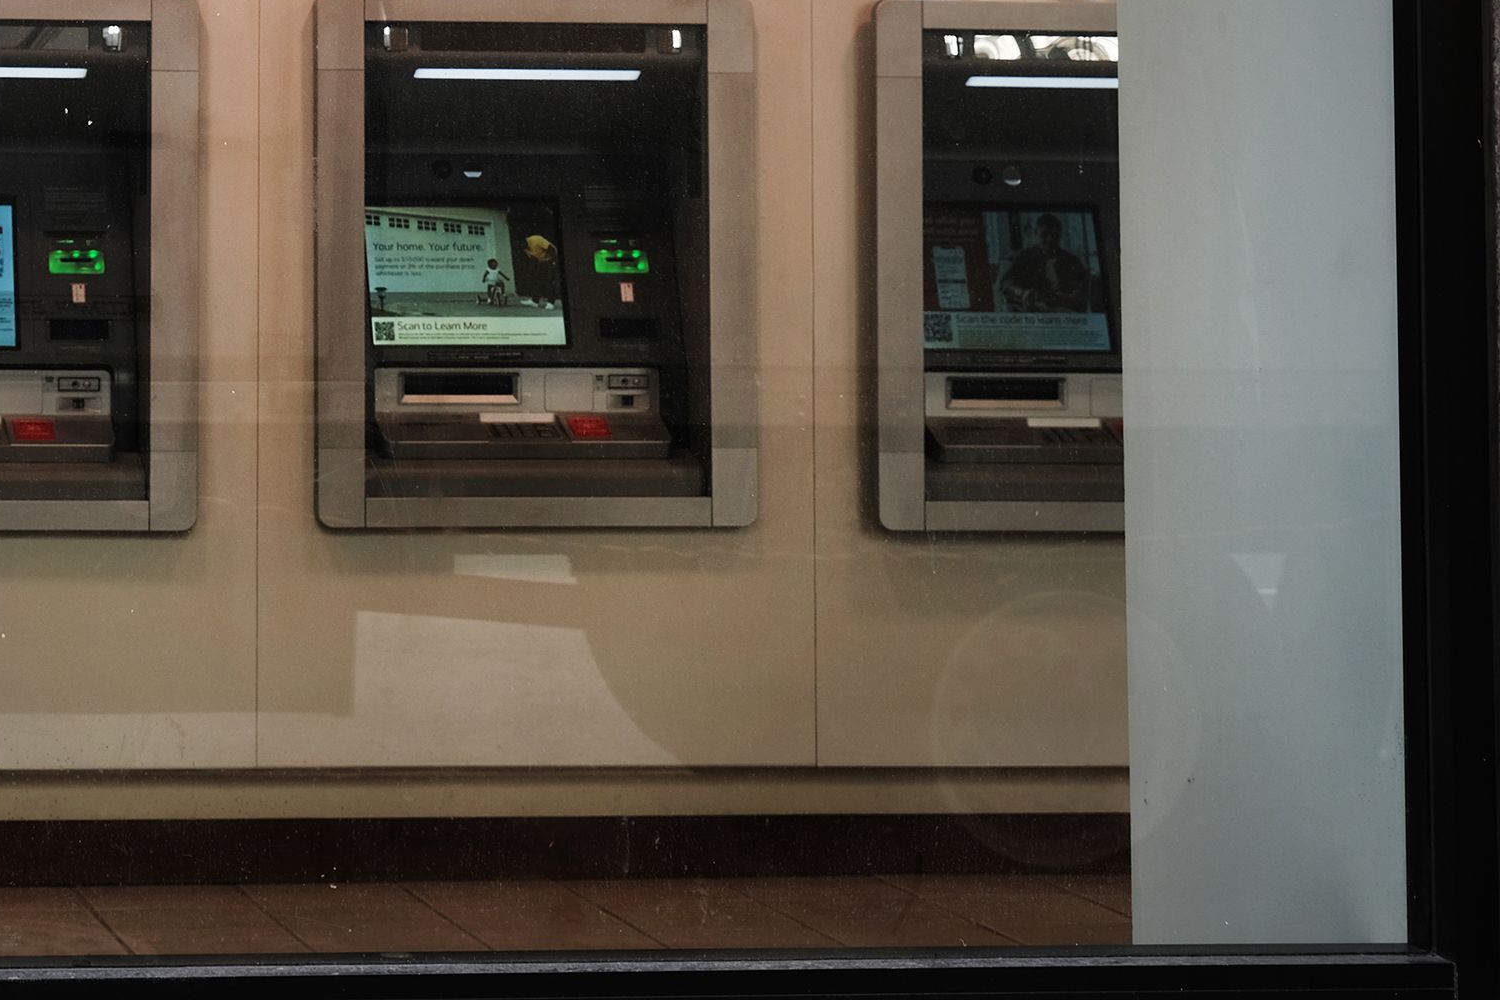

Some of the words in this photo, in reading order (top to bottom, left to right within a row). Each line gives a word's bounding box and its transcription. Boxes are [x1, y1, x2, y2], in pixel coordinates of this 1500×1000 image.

[372, 242, 394, 251] Your
[429, 242, 450, 252] Your
[453, 242, 484, 252] future.
[397, 321, 420, 331] Scan
[422, 322, 433, 331] to
[434, 321, 462, 331] Learn
[463, 321, 488, 331] More
